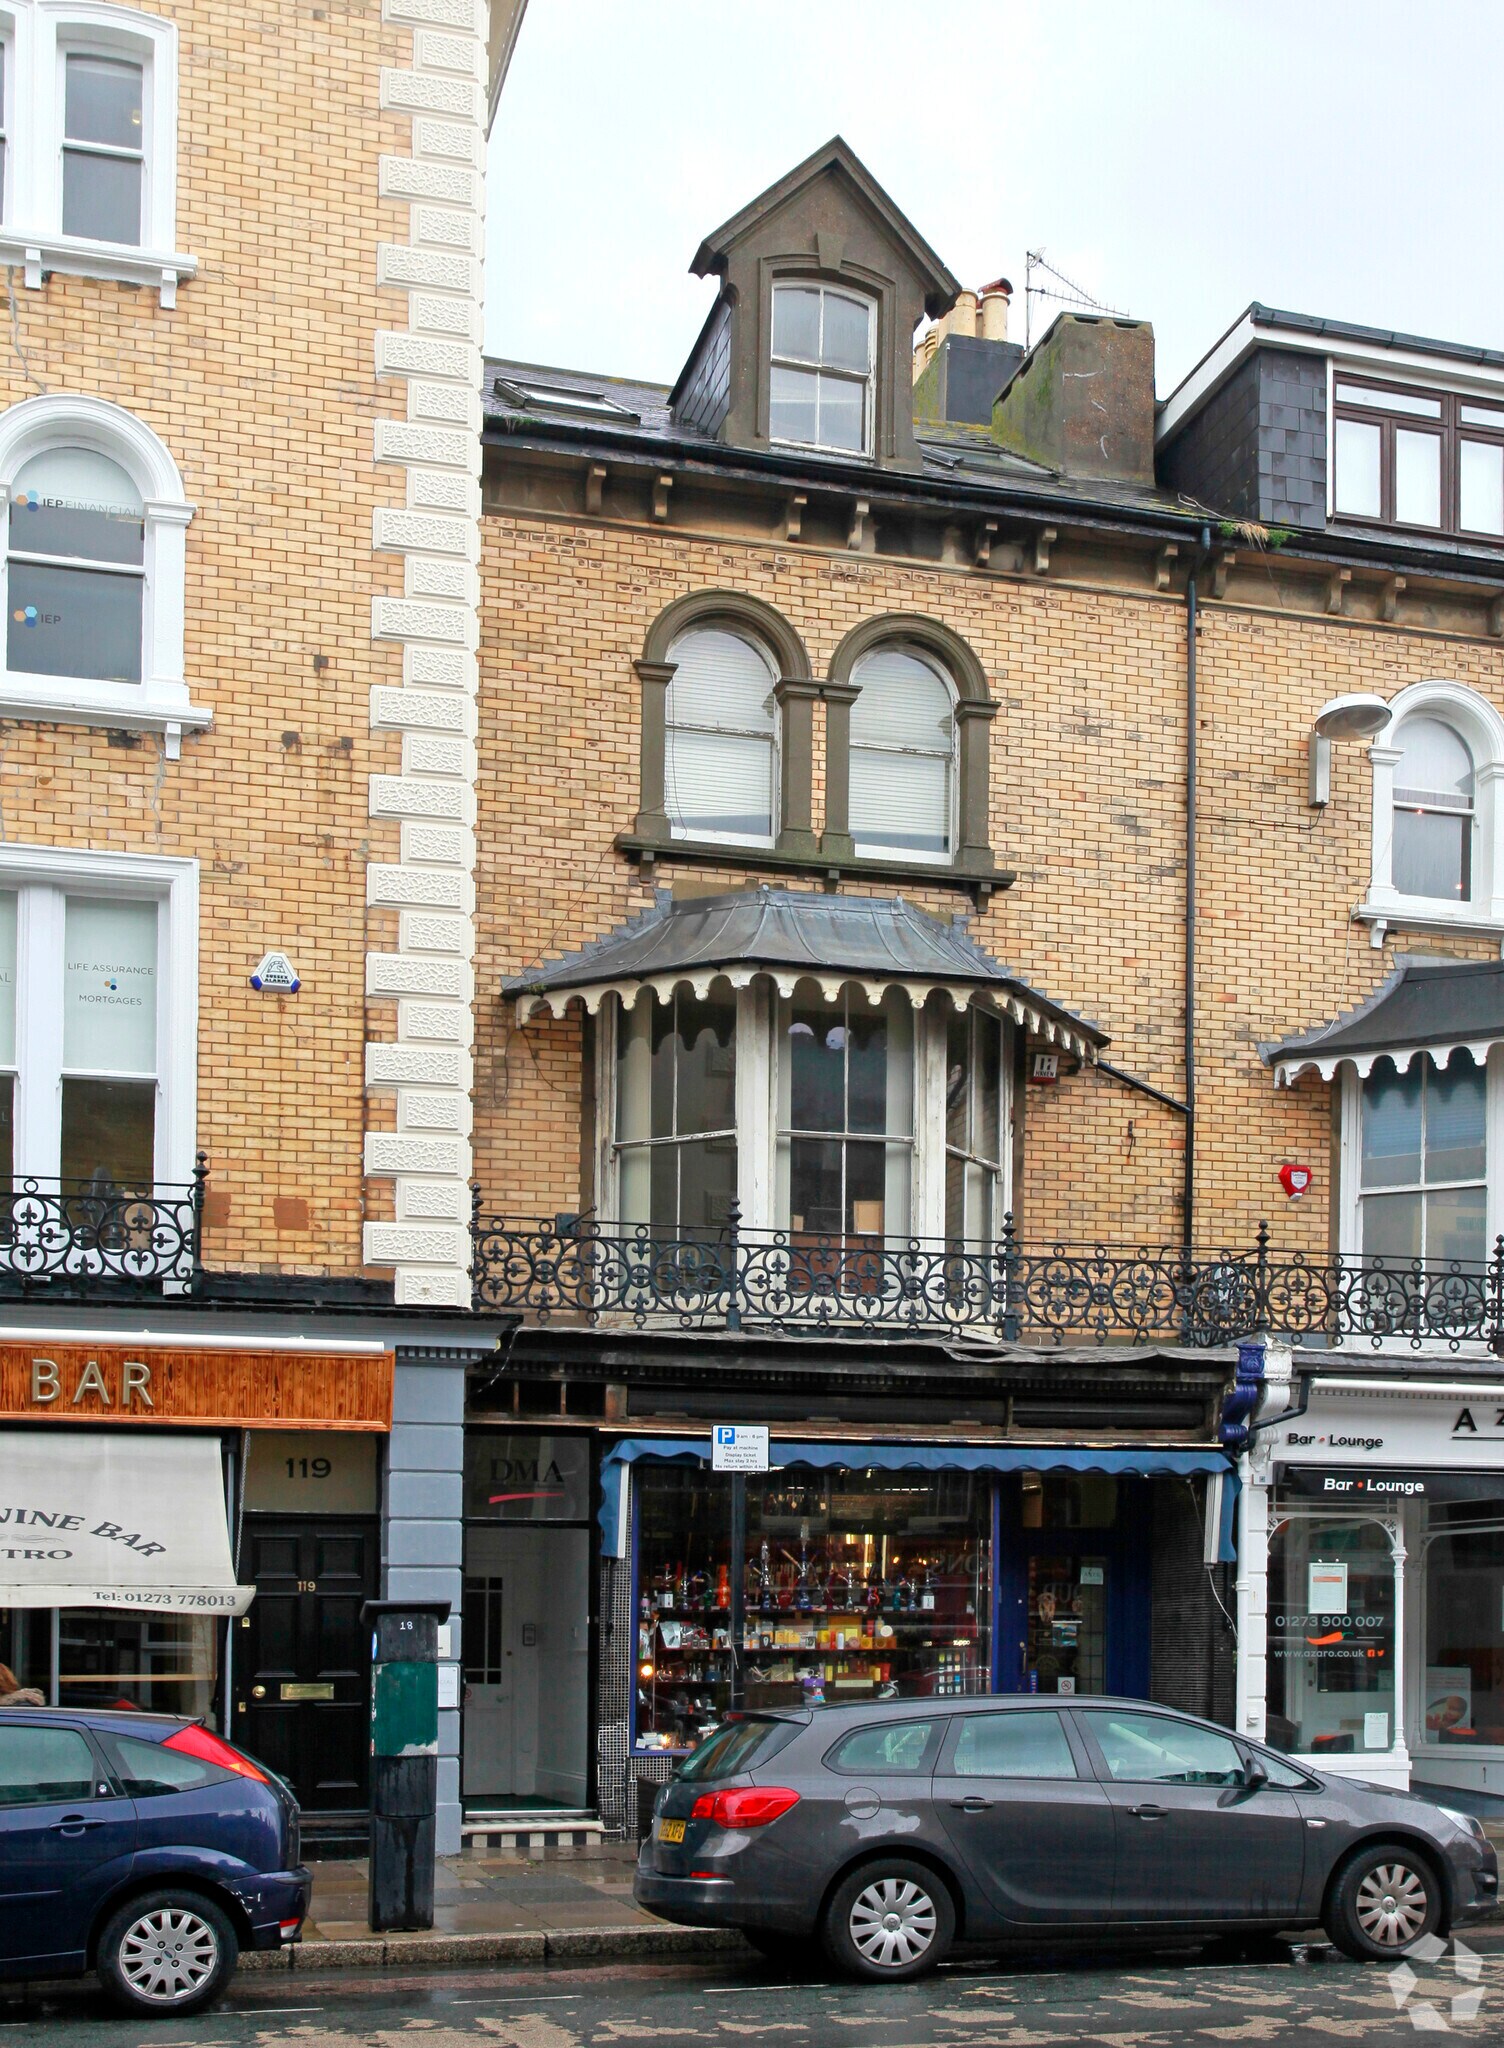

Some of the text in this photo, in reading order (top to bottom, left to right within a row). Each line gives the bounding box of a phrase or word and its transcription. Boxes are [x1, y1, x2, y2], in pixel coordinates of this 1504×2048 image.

[43, 498, 138, 518] IEP FINANCIAL
[40, 613, 61, 625] IEP
[67, 962, 154, 975] LIFE ASSURANCE
[79, 994, 142, 1006] MORTGAGES
[31, 1358, 154, 1406] BAR
[722, 1429, 733, 1443] P
[1288, 1432, 1384, 1450] Bar Lounge
[285, 1457, 332, 1479] 119
[490, 1458, 565, 1482] DMA
[1323, 1478, 1425, 1495] Bar Lounge
[89, 1520, 167, 1557] BAR
[297, 1581, 316, 1592] 119
[93, 1590, 236, 1607] Tel: 01273 778013
[399, 1621, 413, 1630] 18
[1275, 1615, 1385, 1627] 01273 900 007
[1274, 1648, 1364, 1658] www.azaro.co.uk
